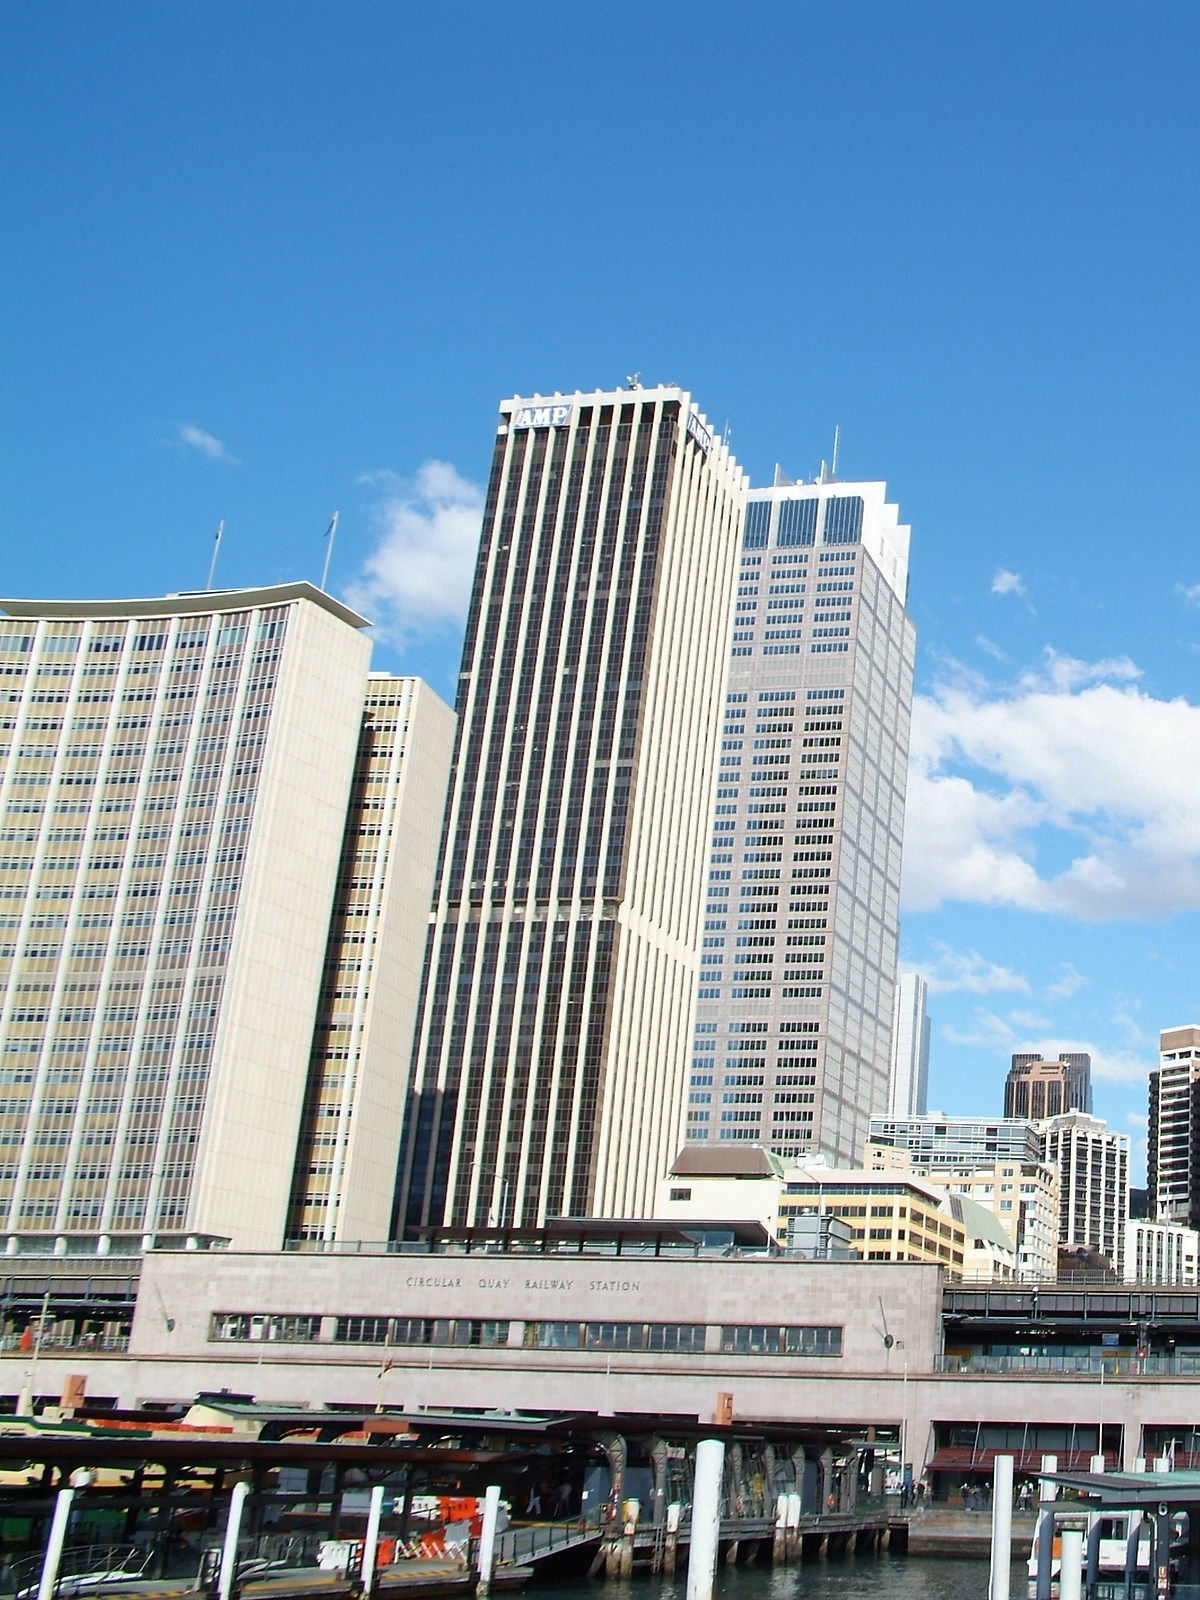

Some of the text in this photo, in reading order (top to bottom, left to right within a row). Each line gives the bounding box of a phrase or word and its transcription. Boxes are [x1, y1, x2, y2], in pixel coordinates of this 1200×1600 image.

[520, 406, 568, 425] AMP
[405, 1276, 641, 1292] CIRCULAR QUAY RAILWAY STATION
[74, 1378, 86, 1399] 4
[1158, 1502, 1168, 1516] 6
